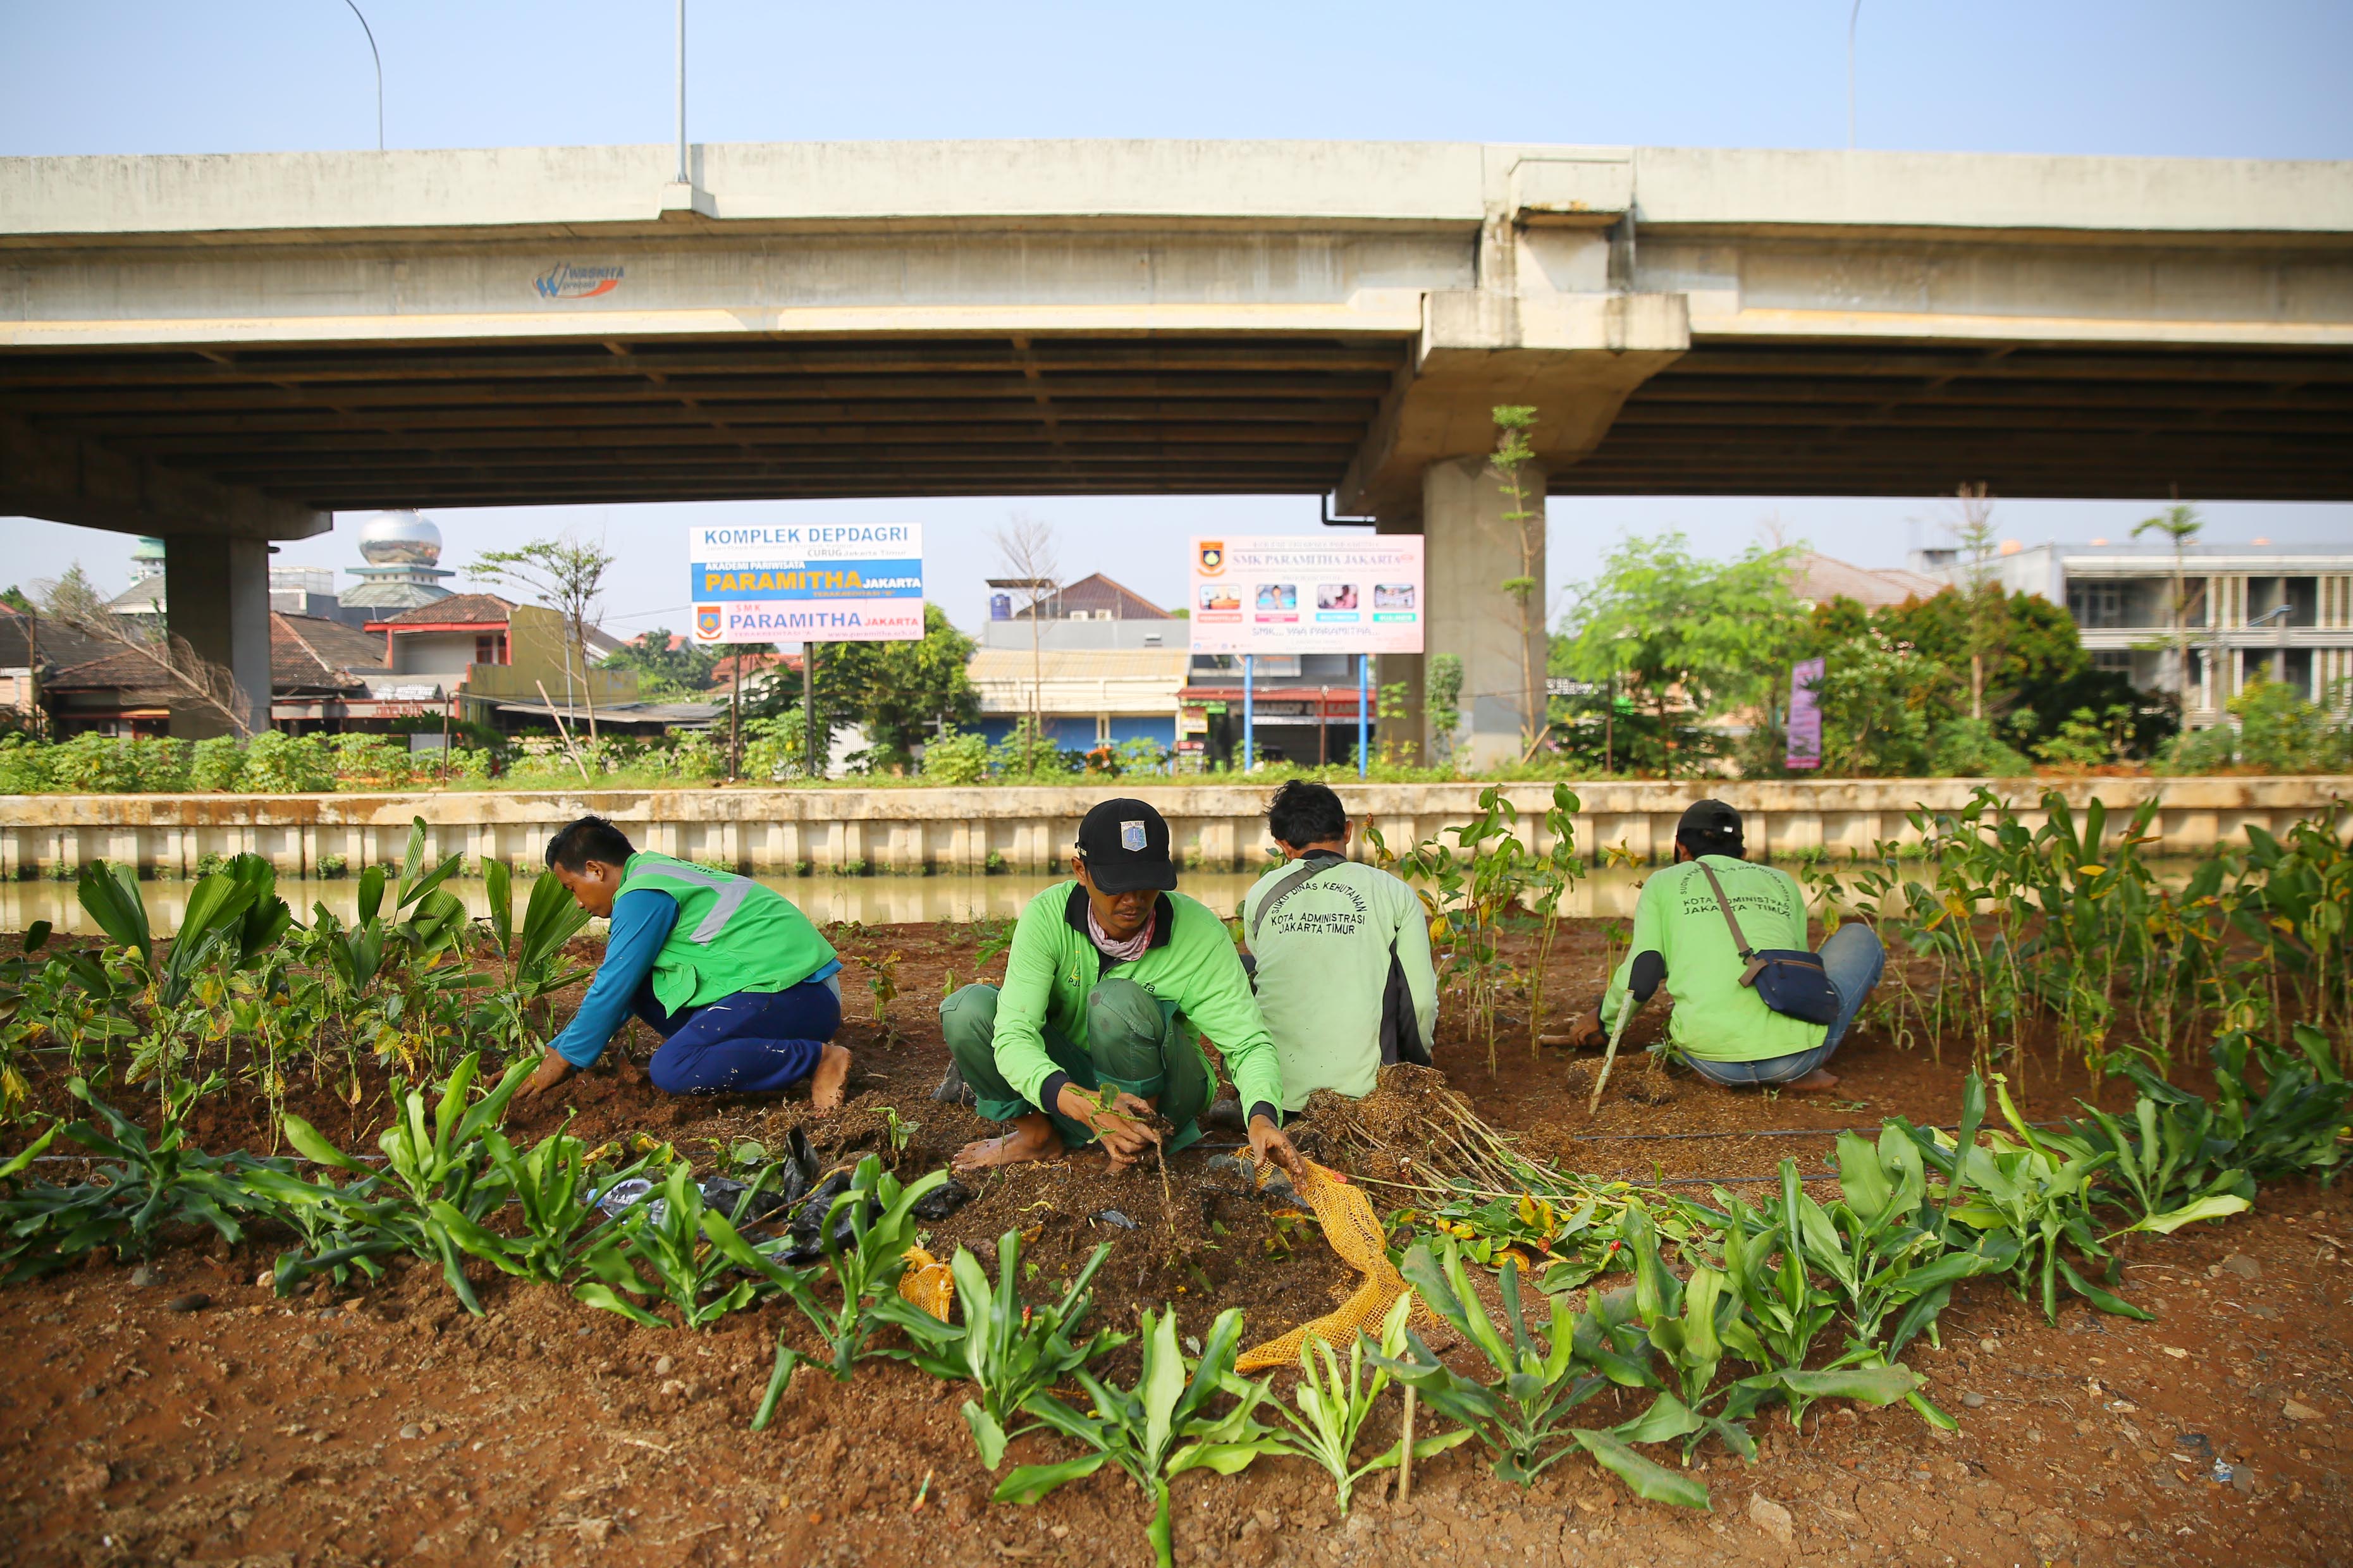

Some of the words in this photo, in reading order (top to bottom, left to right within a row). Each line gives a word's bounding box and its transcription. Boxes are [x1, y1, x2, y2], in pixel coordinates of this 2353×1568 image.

[704, 529, 801, 544] KOMPLEK
[809, 527, 908, 542] DEPDAGRI
[808, 549, 842, 558] CURUG
[705, 561, 749, 571] AKADEMI
[750, 560, 806, 570] PARIWISATA
[1232, 554, 1262, 566] SMK
[1265, 554, 1341, 566] PARAMITHA
[1344, 554, 1401, 566] JAKARTA
[705, 570, 862, 592] PARAMITHA
[863, 577, 921, 589] JAKARTA
[735, 604, 761, 613] SMK
[730, 613, 861, 629] PARAMITHA
[864, 618, 919, 627] JAKARTA
[1272, 895, 1289, 914] SUKU
[1291, 882, 1318, 895] DINAS
[1323, 881, 1367, 912] KEHUTANAN
[1683, 897, 1712, 907] KOTA
[1717, 897, 1791, 910] DMINISTAS
[1684, 905, 1748, 915] JAKATA
[1271, 912, 1294, 926] KOTA
[1300, 912, 1365, 925] ADMINISTRASI
[1279, 922, 1323, 934] JAKARTA
[1326, 923, 1355, 934] TIMUR
